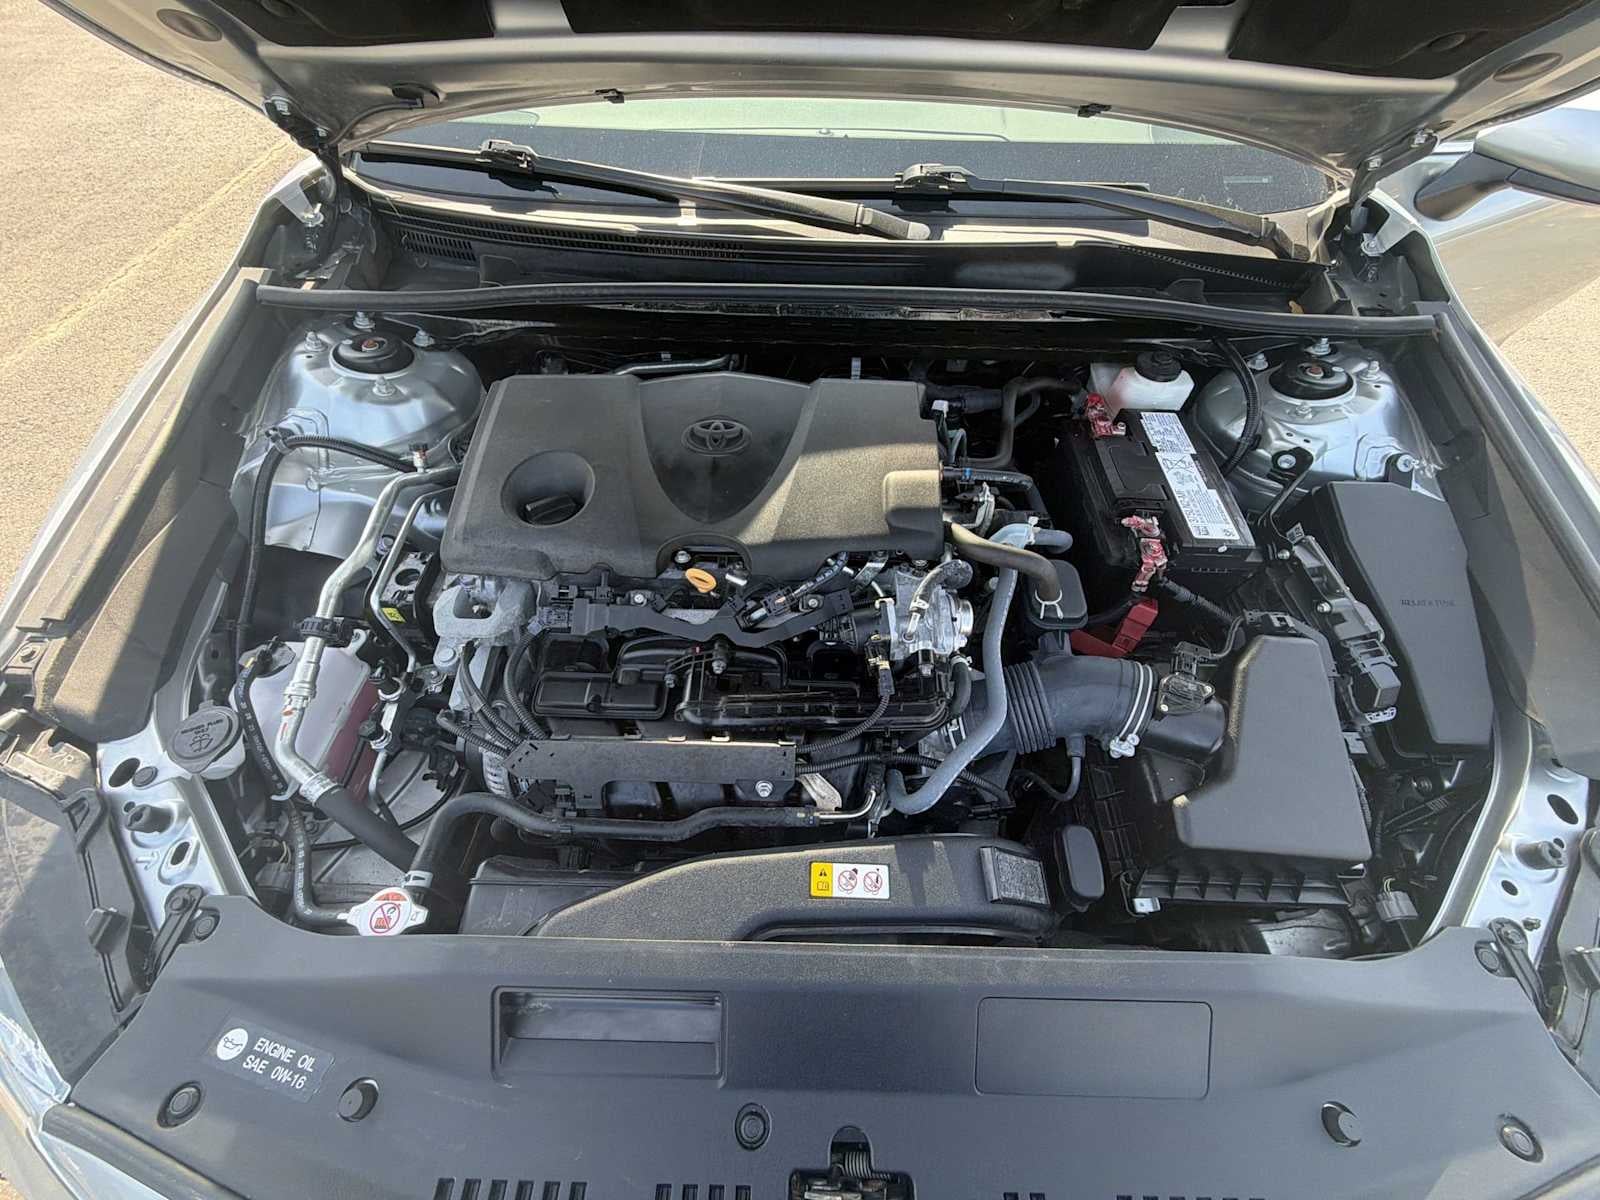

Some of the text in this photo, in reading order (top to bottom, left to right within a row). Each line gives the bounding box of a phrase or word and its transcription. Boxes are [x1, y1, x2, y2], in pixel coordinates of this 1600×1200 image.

[253, 1037, 316, 1072] ENGINE OIL
[242, 1055, 307, 1089] SAE 0W-16
